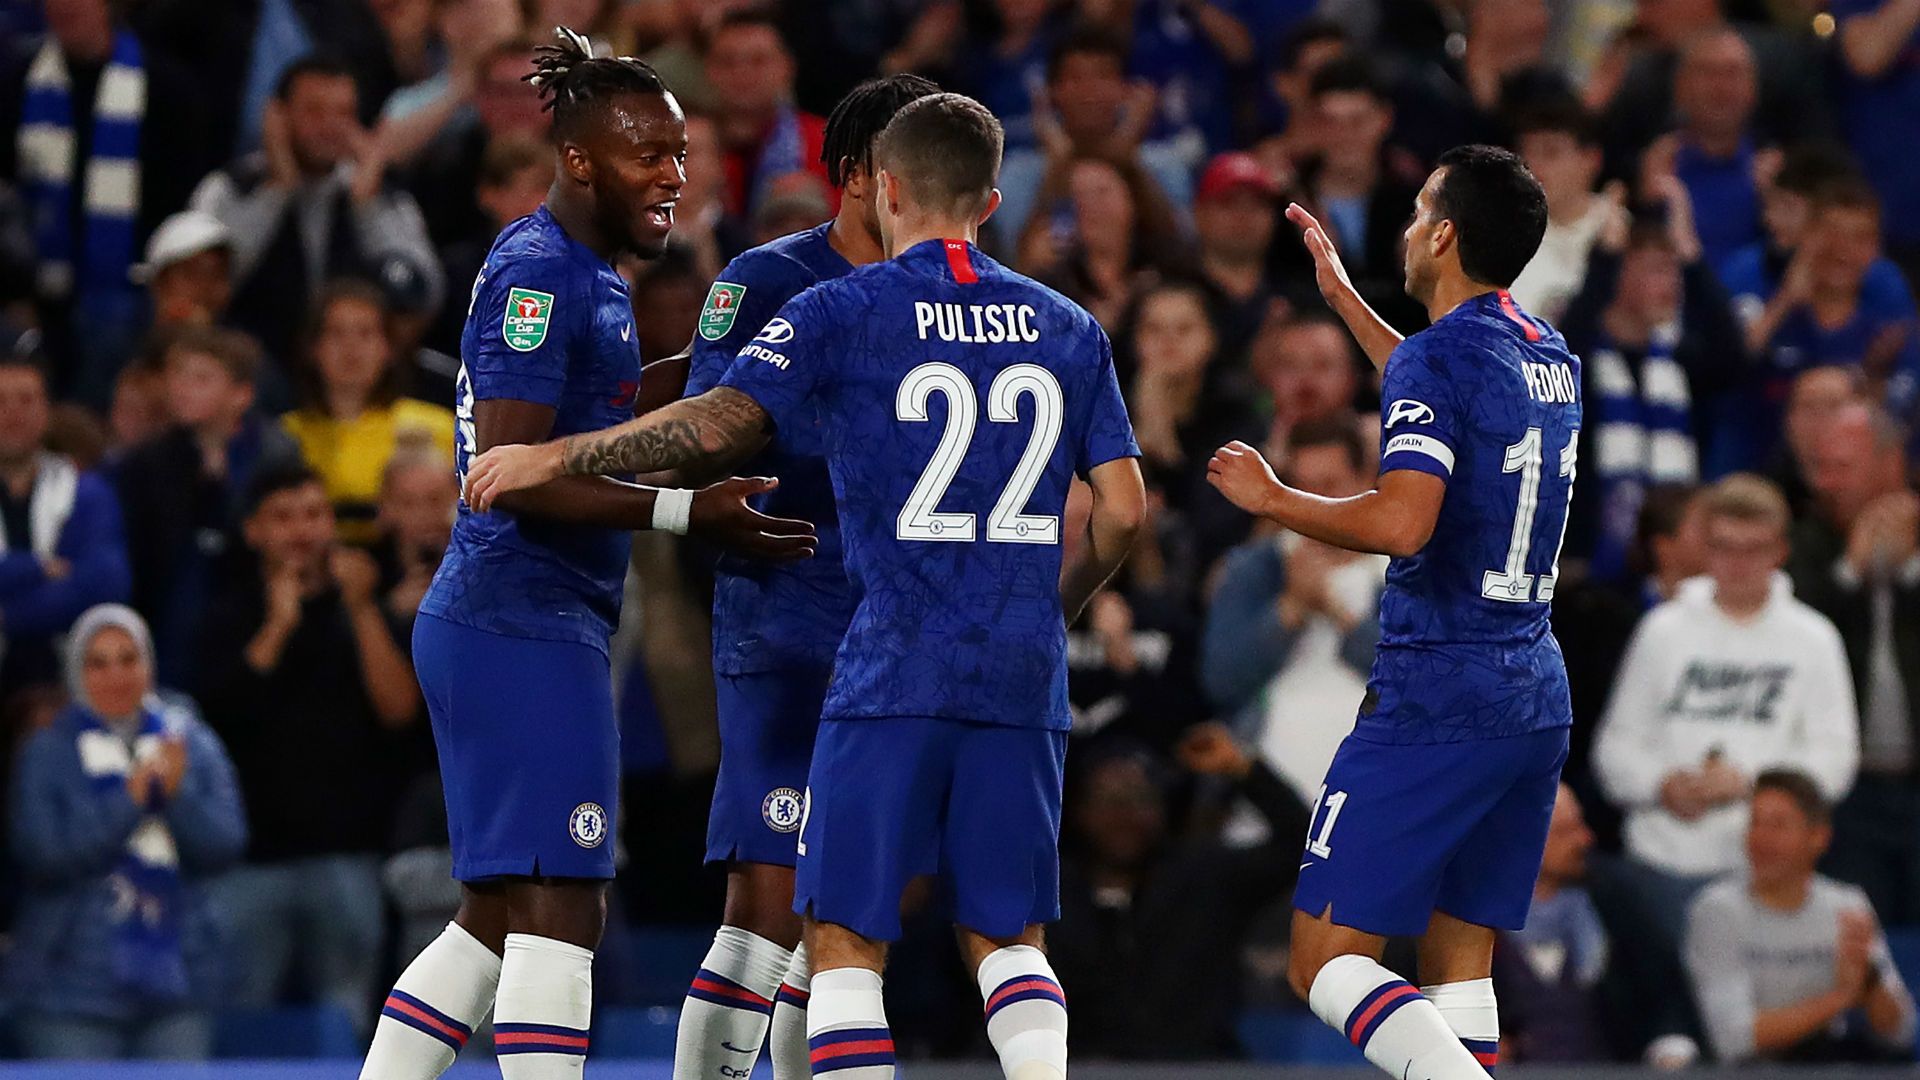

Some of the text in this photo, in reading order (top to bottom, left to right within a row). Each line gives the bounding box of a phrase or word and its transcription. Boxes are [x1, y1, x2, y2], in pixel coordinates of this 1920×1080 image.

[915, 301, 1039, 343] PULISIC
[1521, 361, 1575, 403] PEDRO
[896, 361, 1064, 544] 22
[720, 1065, 750, 1079] CFC
